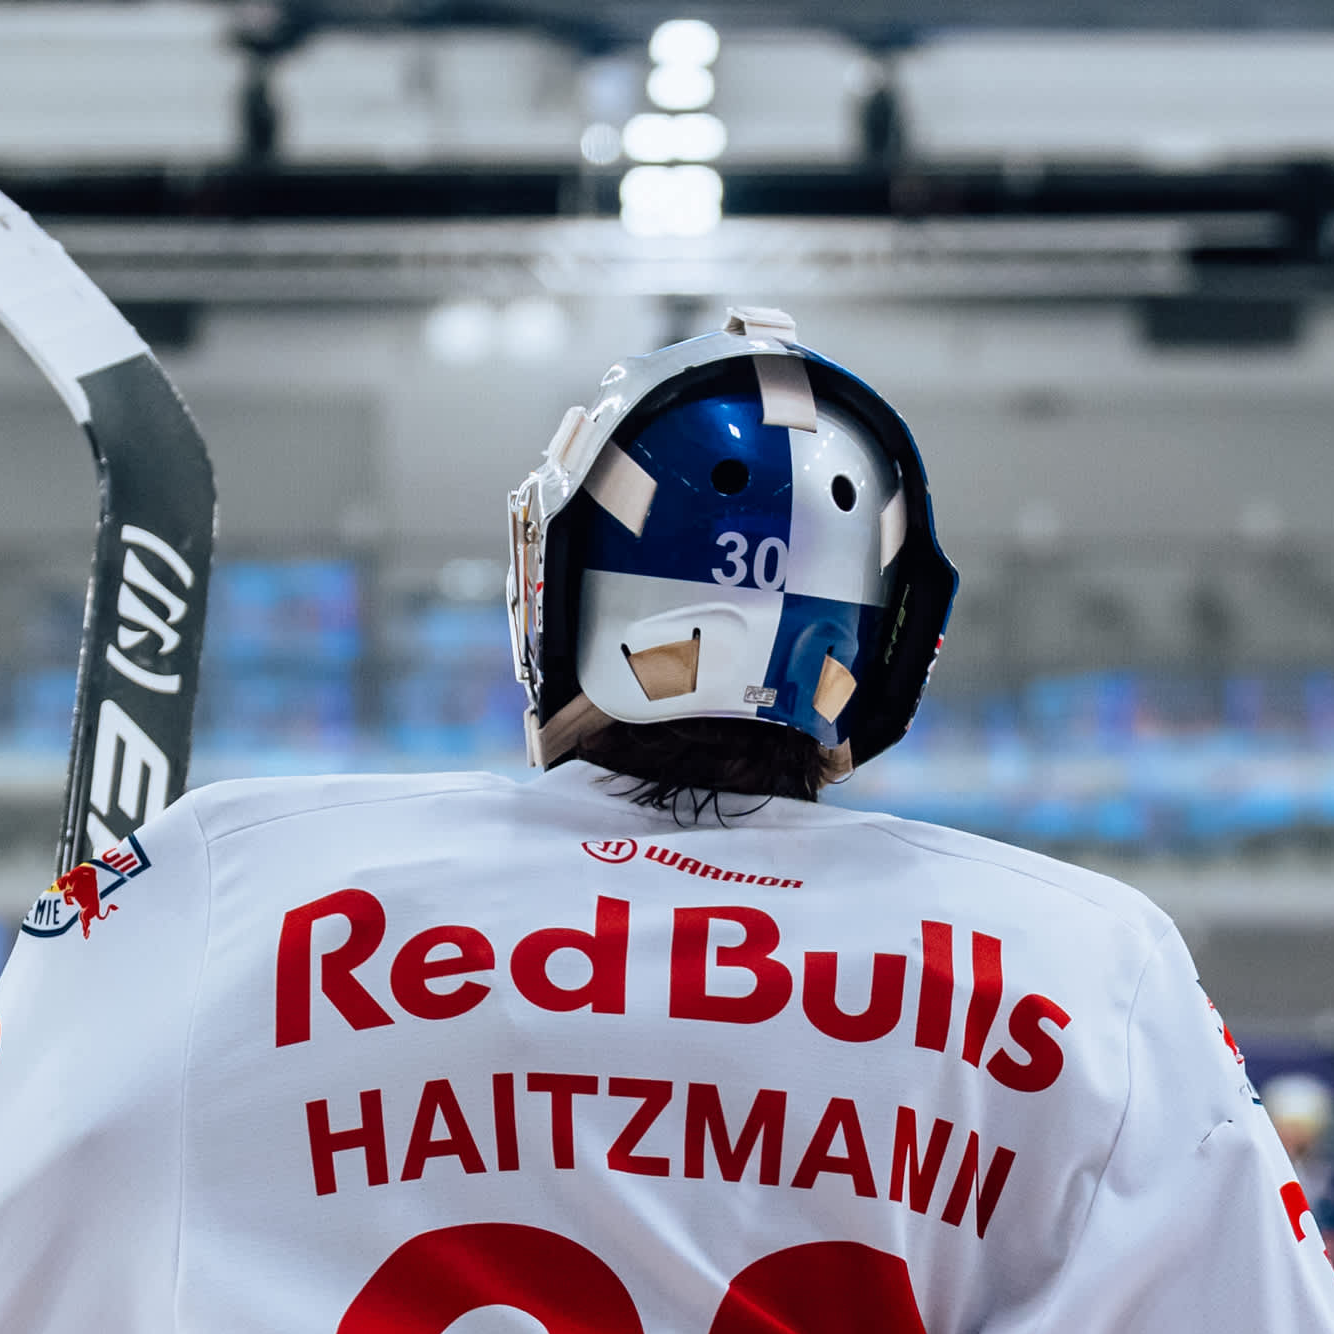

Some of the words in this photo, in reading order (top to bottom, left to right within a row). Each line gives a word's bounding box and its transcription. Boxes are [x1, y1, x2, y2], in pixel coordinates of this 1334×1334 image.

[710, 531, 789, 592] 30
[644, 845, 804, 889] WARRIOR
[275, 888, 630, 1048] Red
[668, 905, 1072, 1093] Bulls
[305, 1072, 1015, 1241] HAITZMANN
